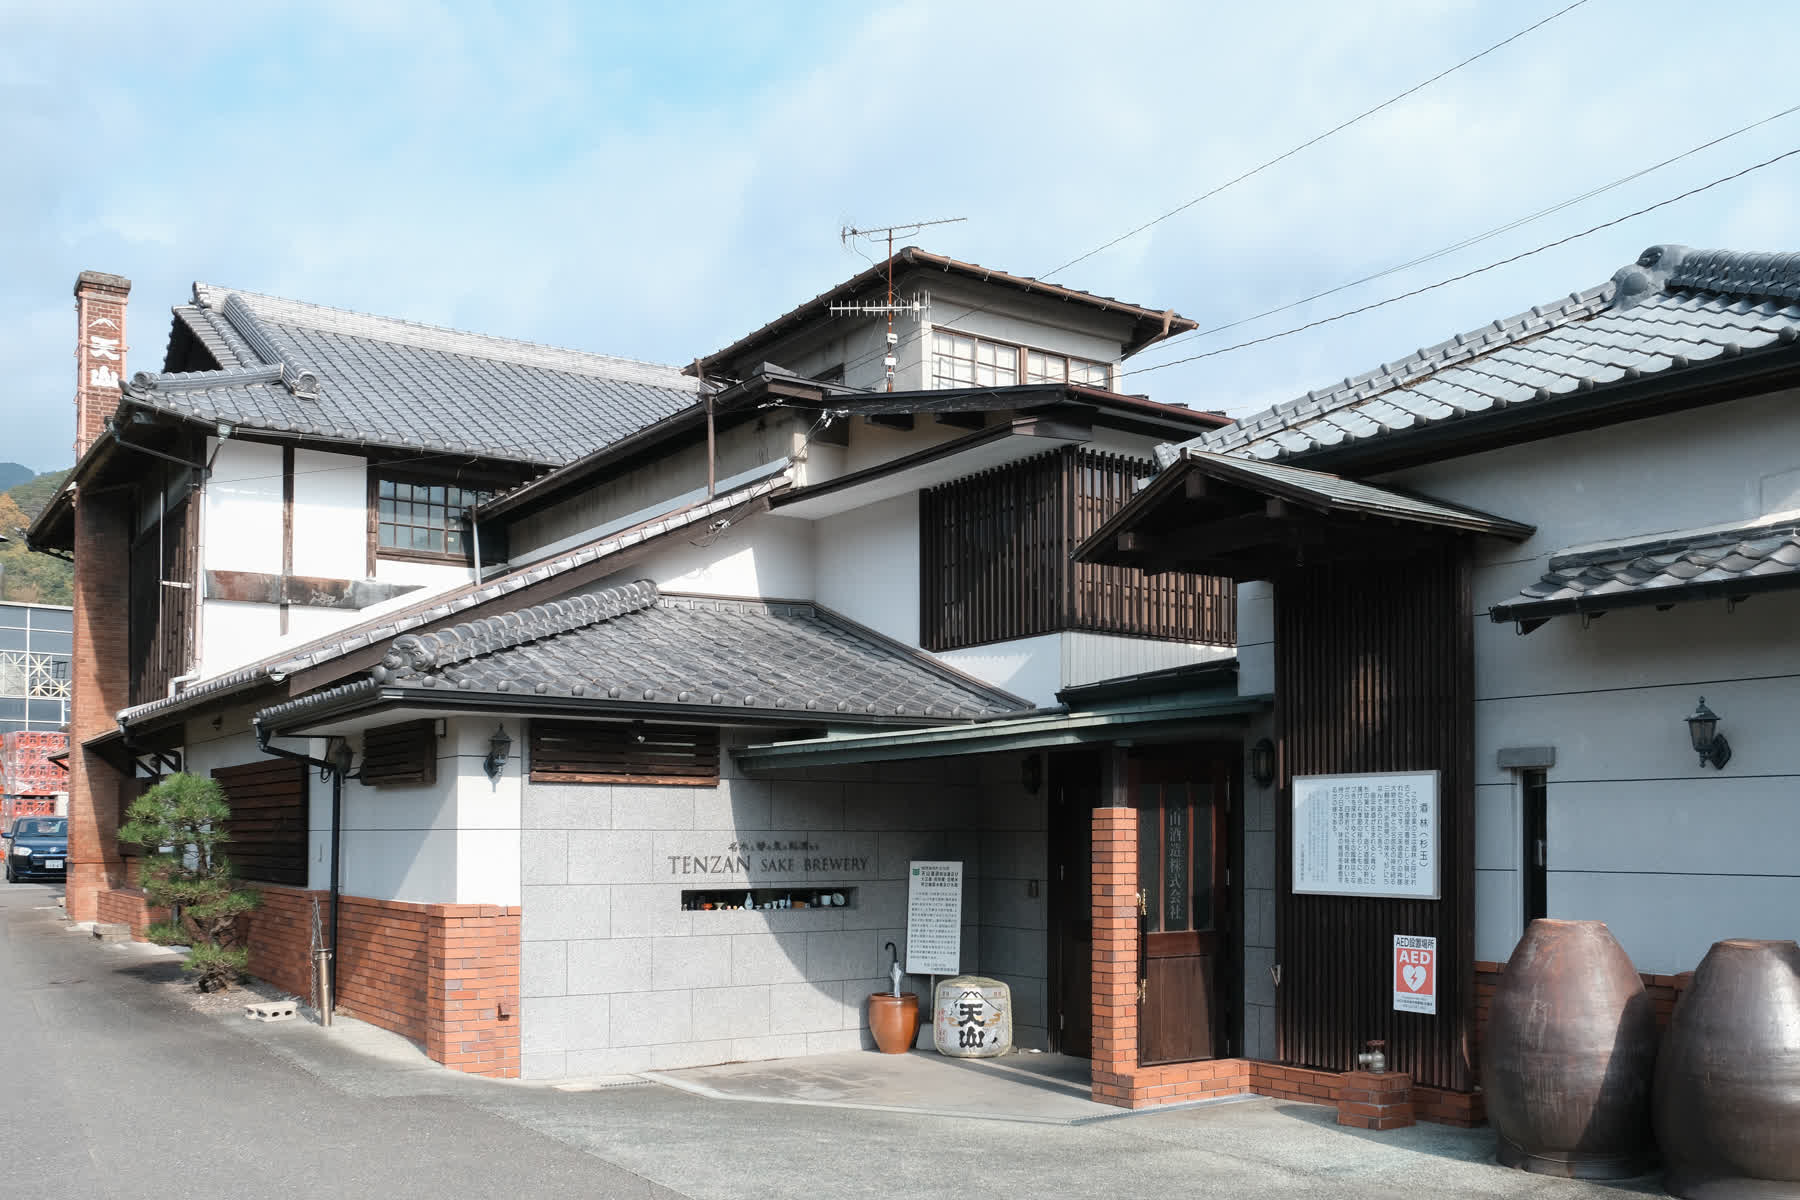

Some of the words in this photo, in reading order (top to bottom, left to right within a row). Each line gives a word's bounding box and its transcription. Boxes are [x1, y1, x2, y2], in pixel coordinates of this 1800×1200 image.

[90, 335, 120, 388] 天山
[667, 855, 750, 874] TENZAN
[761, 857, 795, 873] SAKE
[804, 855, 870, 872] BREWERY
[1396, 937, 1435, 950] AED設置場所
[1400, 949, 1431, 965] AED
[958, 1003, 986, 1048] 天山
